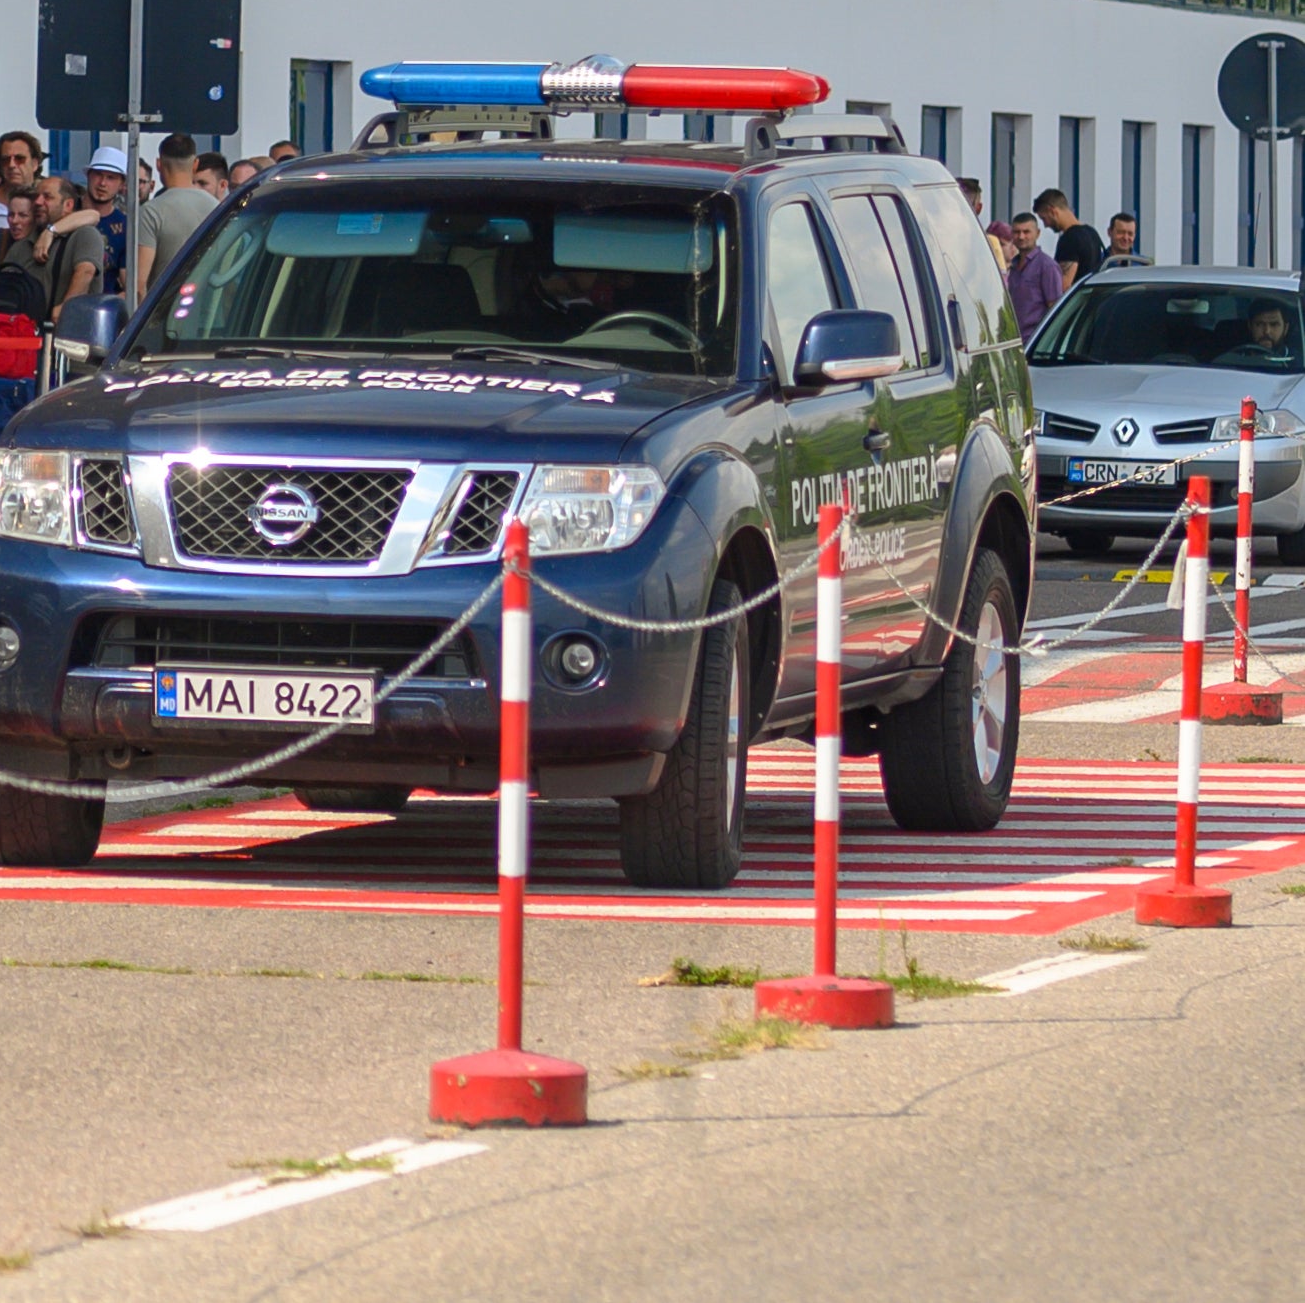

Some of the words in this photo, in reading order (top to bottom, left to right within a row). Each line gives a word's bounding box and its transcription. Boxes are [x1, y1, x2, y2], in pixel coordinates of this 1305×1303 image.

[286, 369, 350, 379] DE
[219, 379, 350, 389] BORDER
[362, 380, 477, 394] POLICE
[846, 467, 866, 515] DE
[867, 444, 939, 512] FRONTIERĂ
[1084, 463, 1119, 482] CRN
[255, 507, 309, 519] NISSAN
[160, 697, 176, 712] MD
[183, 678, 256, 716] MAI
[274, 682, 363, 719] 8422
